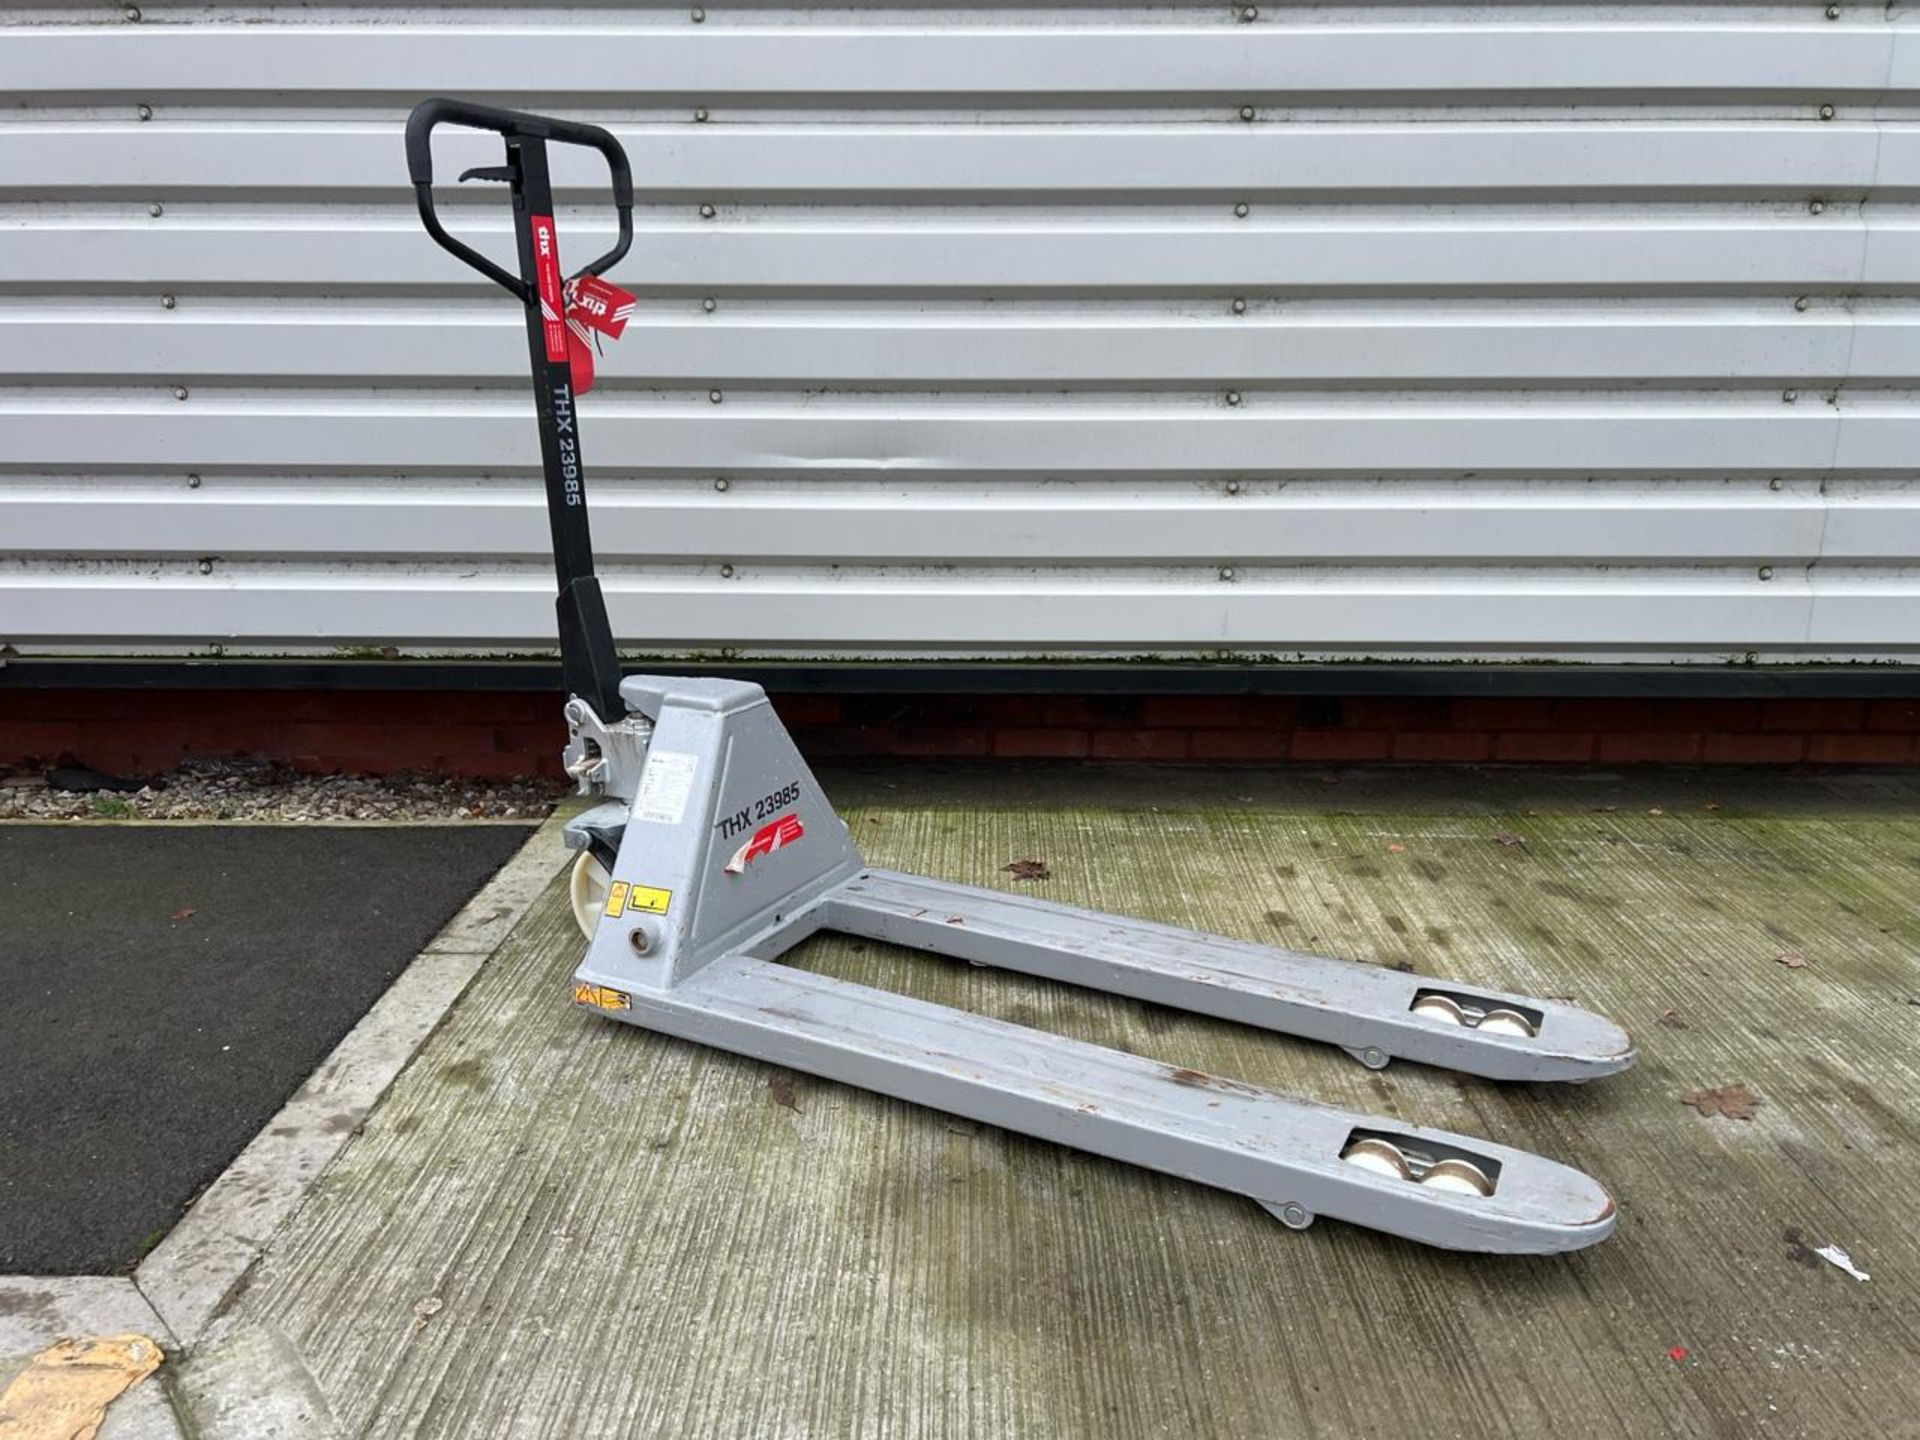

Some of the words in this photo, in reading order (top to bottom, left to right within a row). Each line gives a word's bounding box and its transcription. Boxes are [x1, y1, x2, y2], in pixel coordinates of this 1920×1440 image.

[553, 383, 573, 433] THX
[558, 438, 581, 507] 23985
[714, 807, 752, 840] THX
[755, 780, 800, 820] 23985
